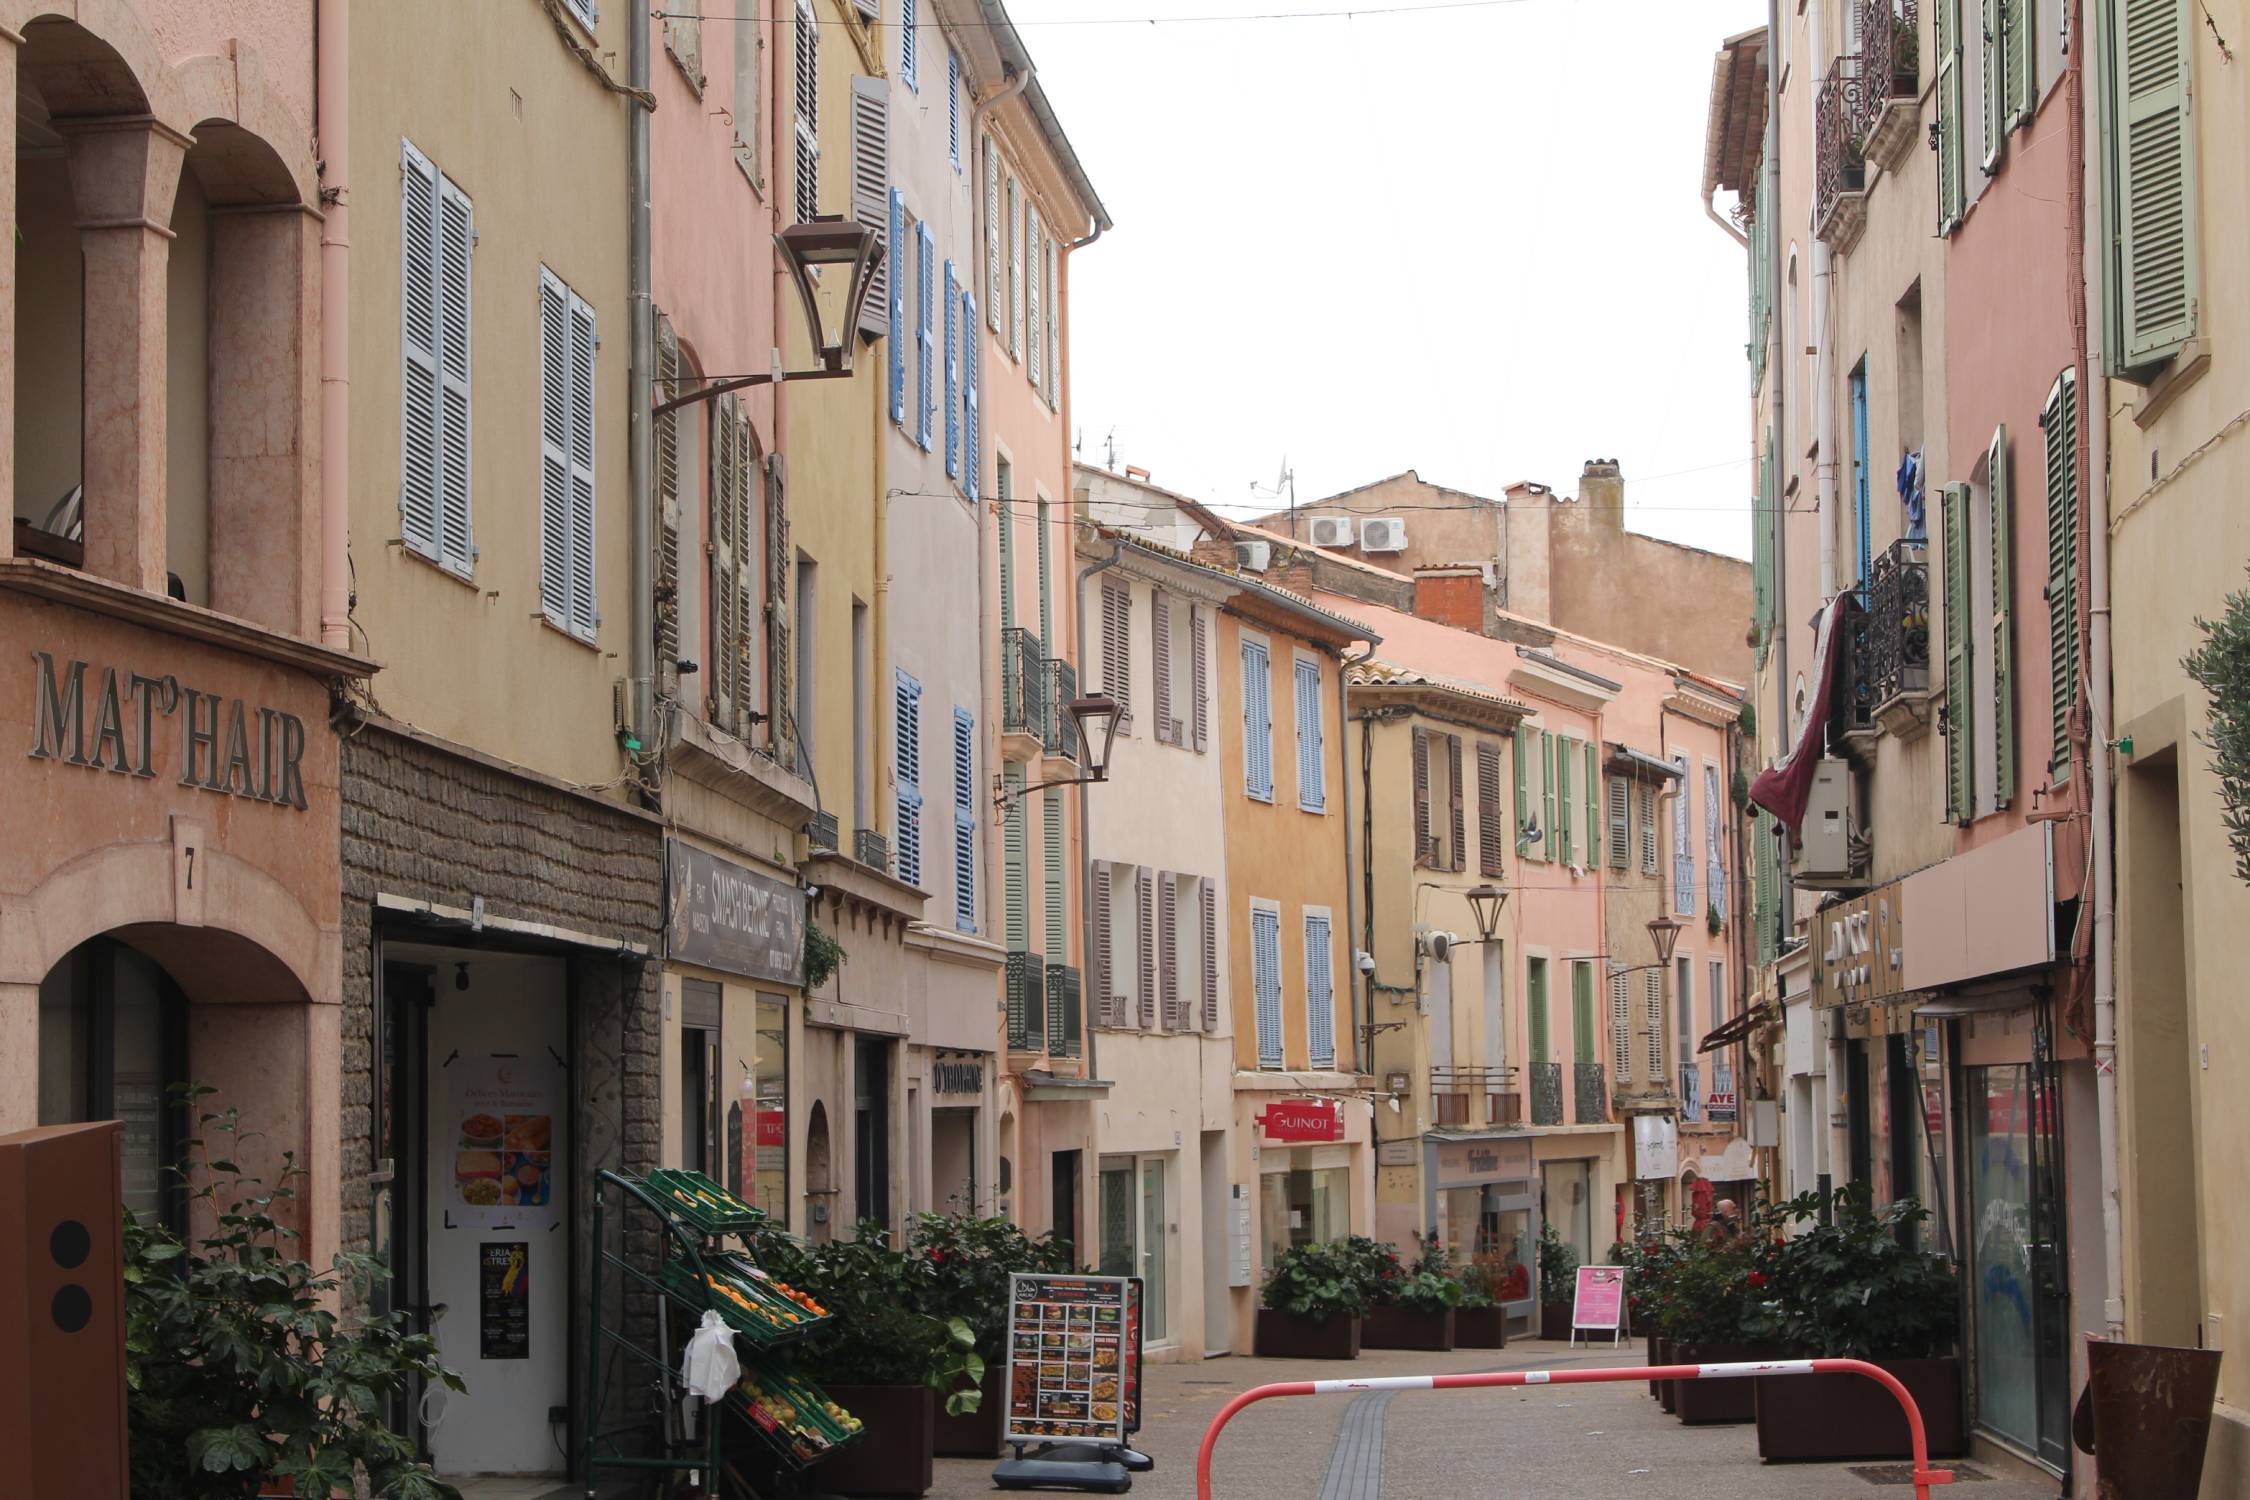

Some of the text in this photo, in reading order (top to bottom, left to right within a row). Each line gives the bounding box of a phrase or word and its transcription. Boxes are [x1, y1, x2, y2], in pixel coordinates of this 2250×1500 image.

[28, 650, 309, 811] MAT'HAIR
[184, 847, 195, 889] 7
[711, 870, 741, 930] SMASH
[1708, 1093, 1735, 1104] AYE
[1272, 1111, 1329, 1130] GUINOT
